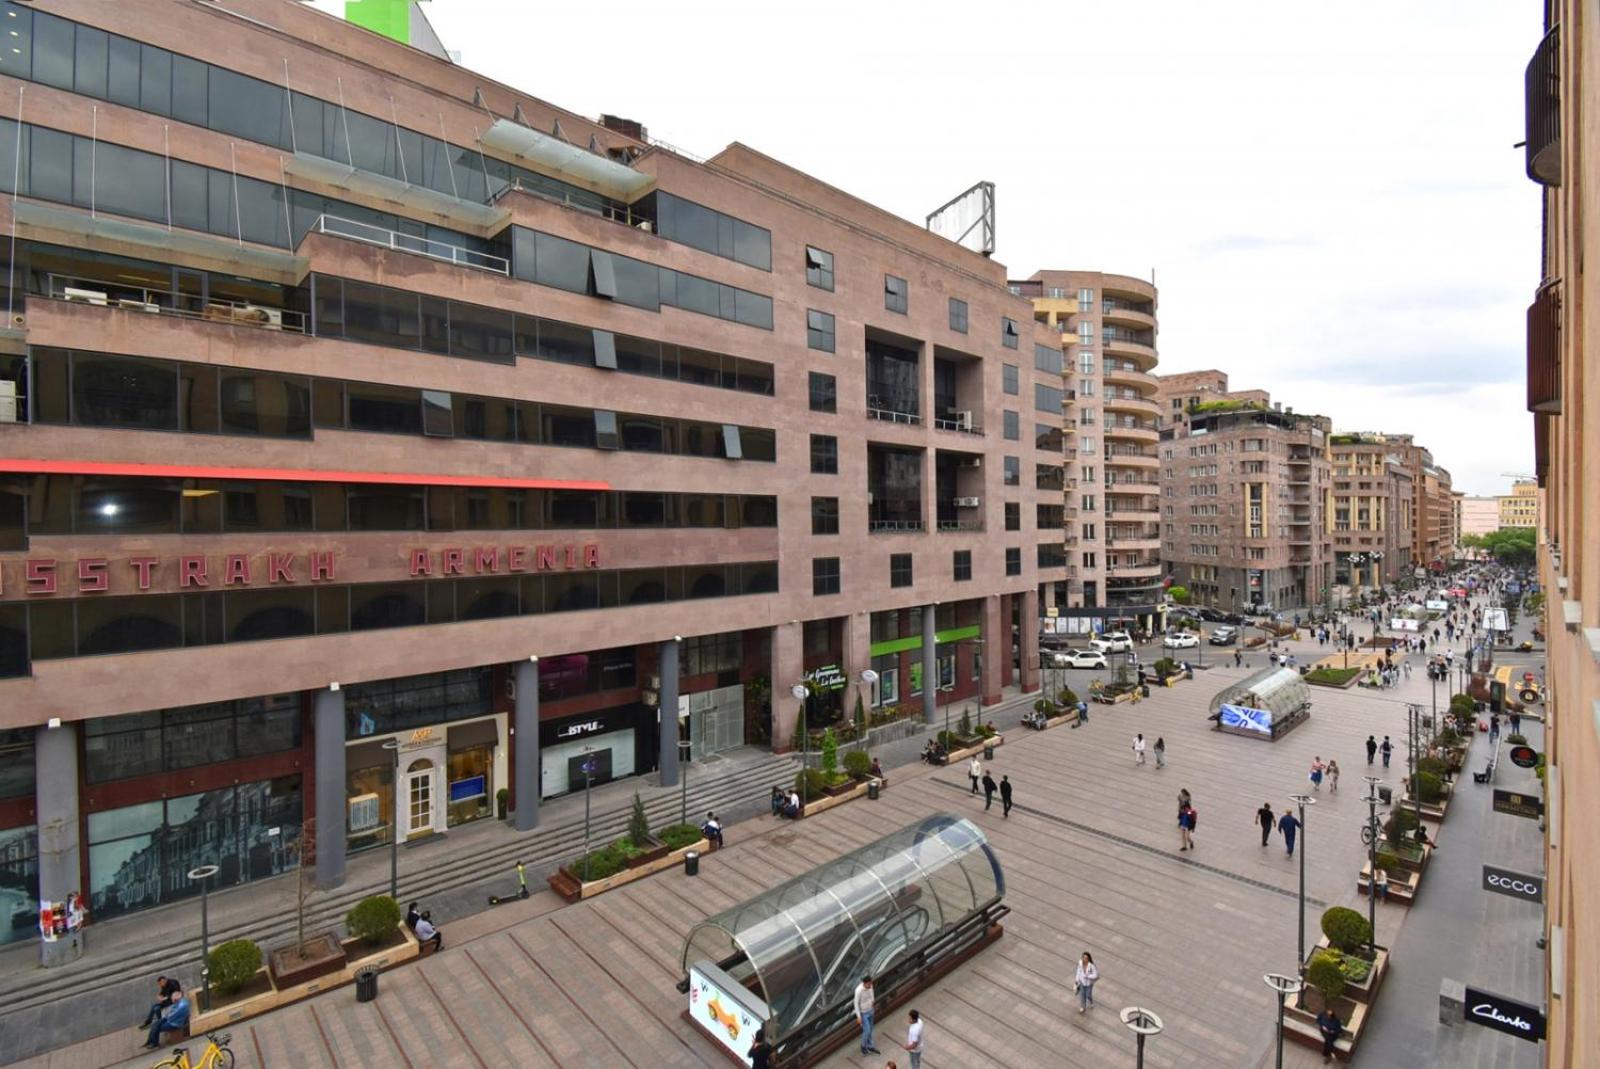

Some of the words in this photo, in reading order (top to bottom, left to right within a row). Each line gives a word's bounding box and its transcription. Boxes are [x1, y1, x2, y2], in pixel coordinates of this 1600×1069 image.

[0, 551, 335, 595] SSTRAKH
[410, 544, 600, 576] ARMENIA
[1488, 874, 1537, 894] ecco
[1472, 1004, 1531, 1030] Clarks
